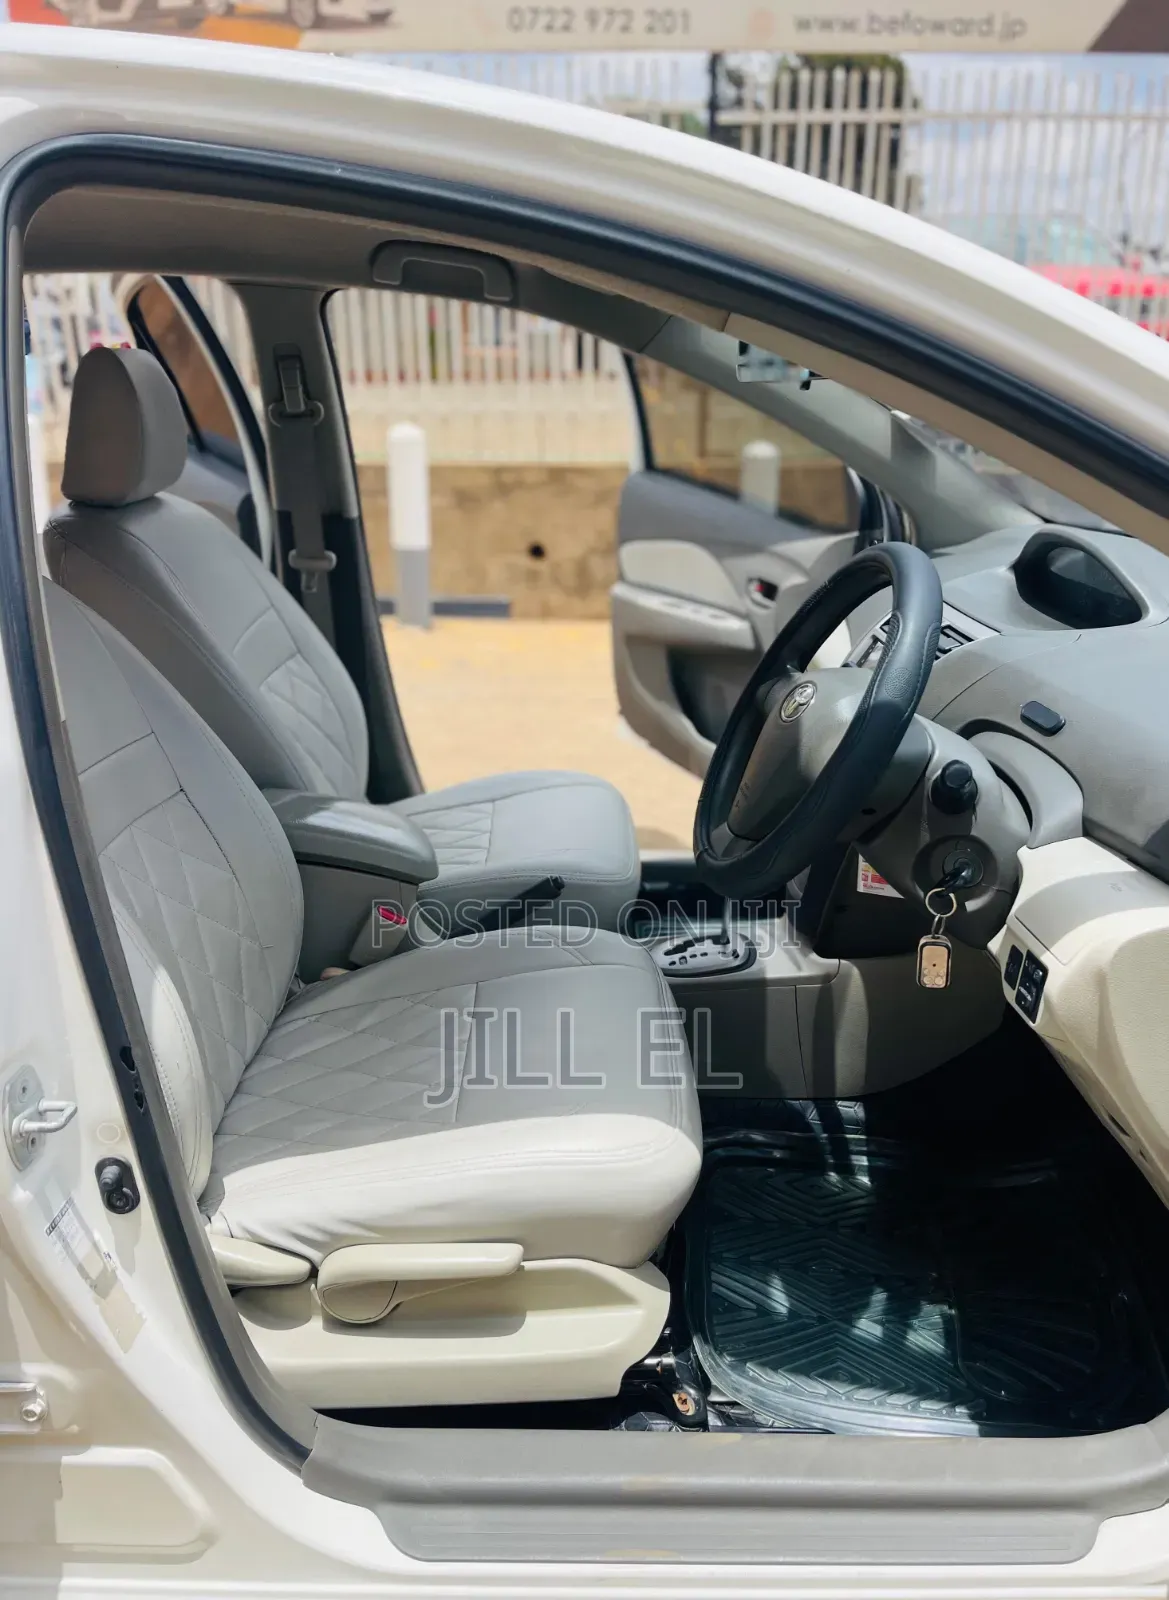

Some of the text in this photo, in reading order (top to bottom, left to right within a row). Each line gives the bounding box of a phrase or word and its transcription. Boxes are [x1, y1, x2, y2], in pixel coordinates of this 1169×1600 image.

[505, 6, 692, 35] 0722 972 201
